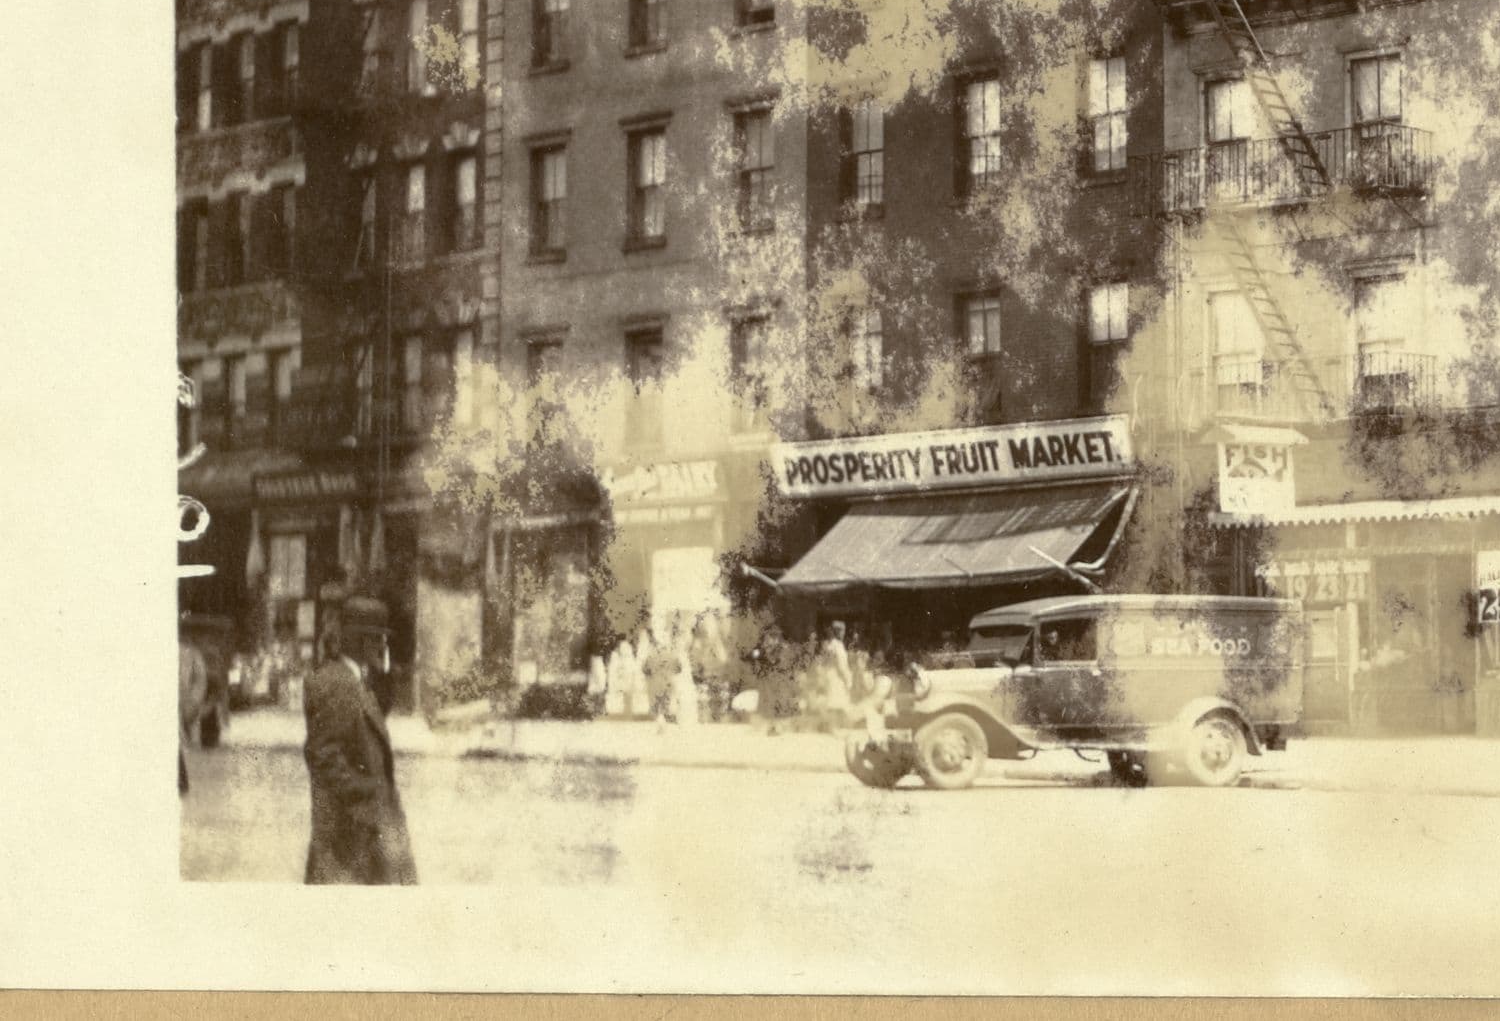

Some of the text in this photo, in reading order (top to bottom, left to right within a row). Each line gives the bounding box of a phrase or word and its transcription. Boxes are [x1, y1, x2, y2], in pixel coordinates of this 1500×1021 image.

[785, 448, 922, 486] PROSPERITY
[929, 440, 1000, 476] FRUIT
[1225, 443, 1287, 470] FISH
